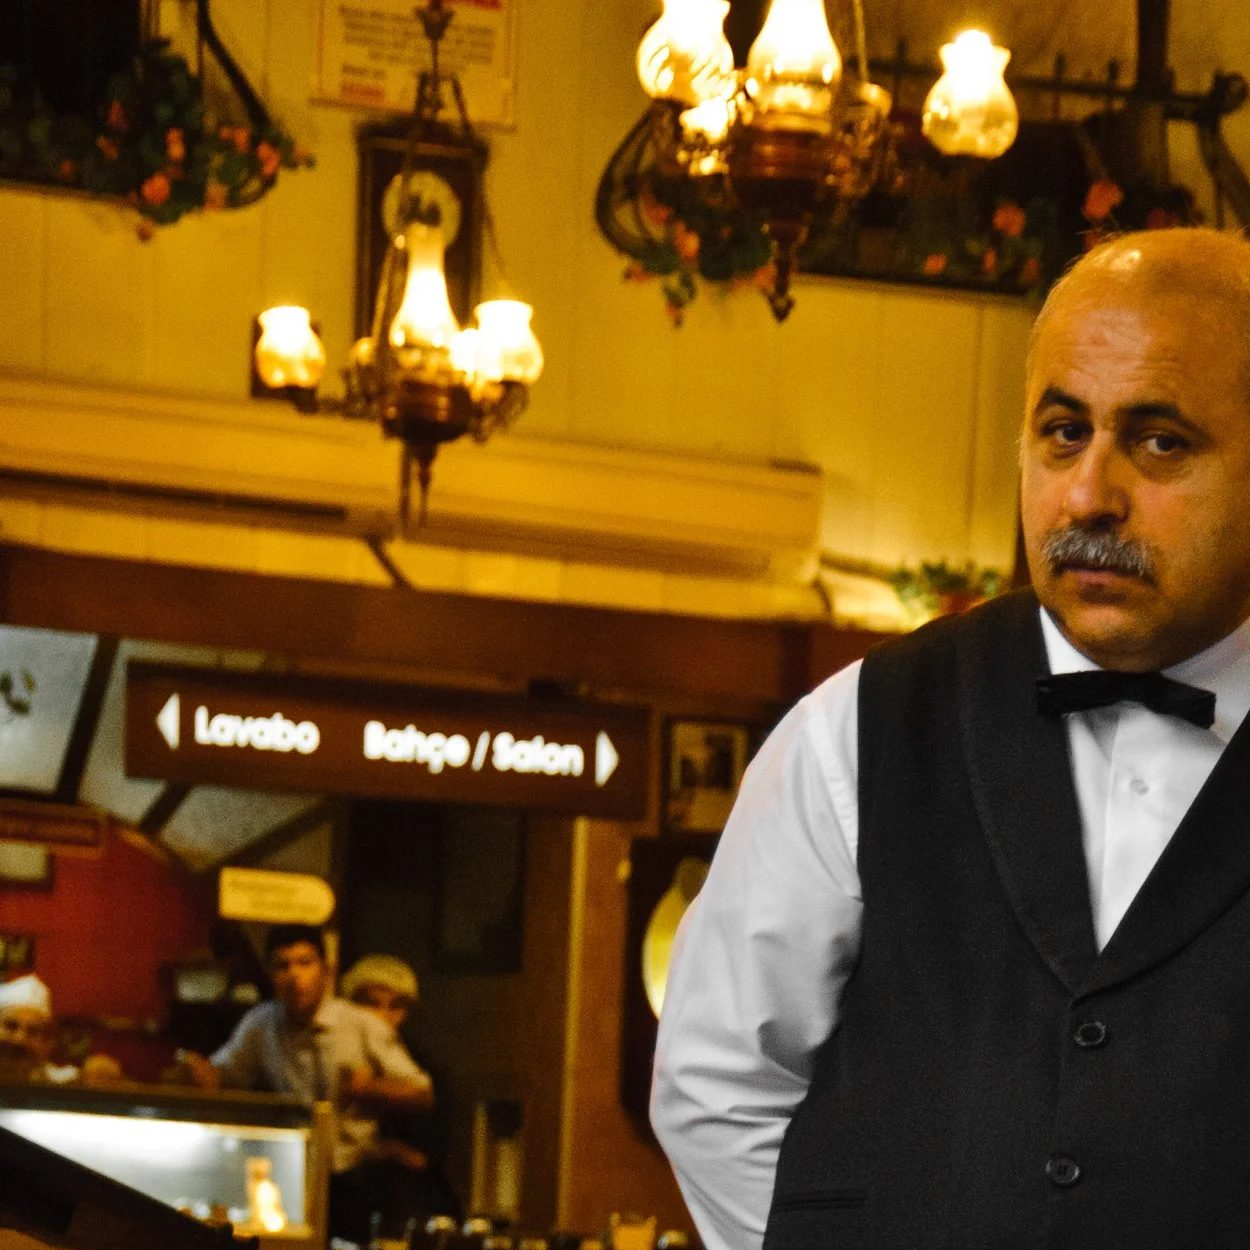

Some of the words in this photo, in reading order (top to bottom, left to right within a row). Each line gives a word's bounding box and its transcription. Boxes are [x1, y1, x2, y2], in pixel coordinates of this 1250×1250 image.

[195, 705, 320, 755] Lavabo
[364, 720, 471, 775] Bahçe
[492, 731, 585, 777] Salon
